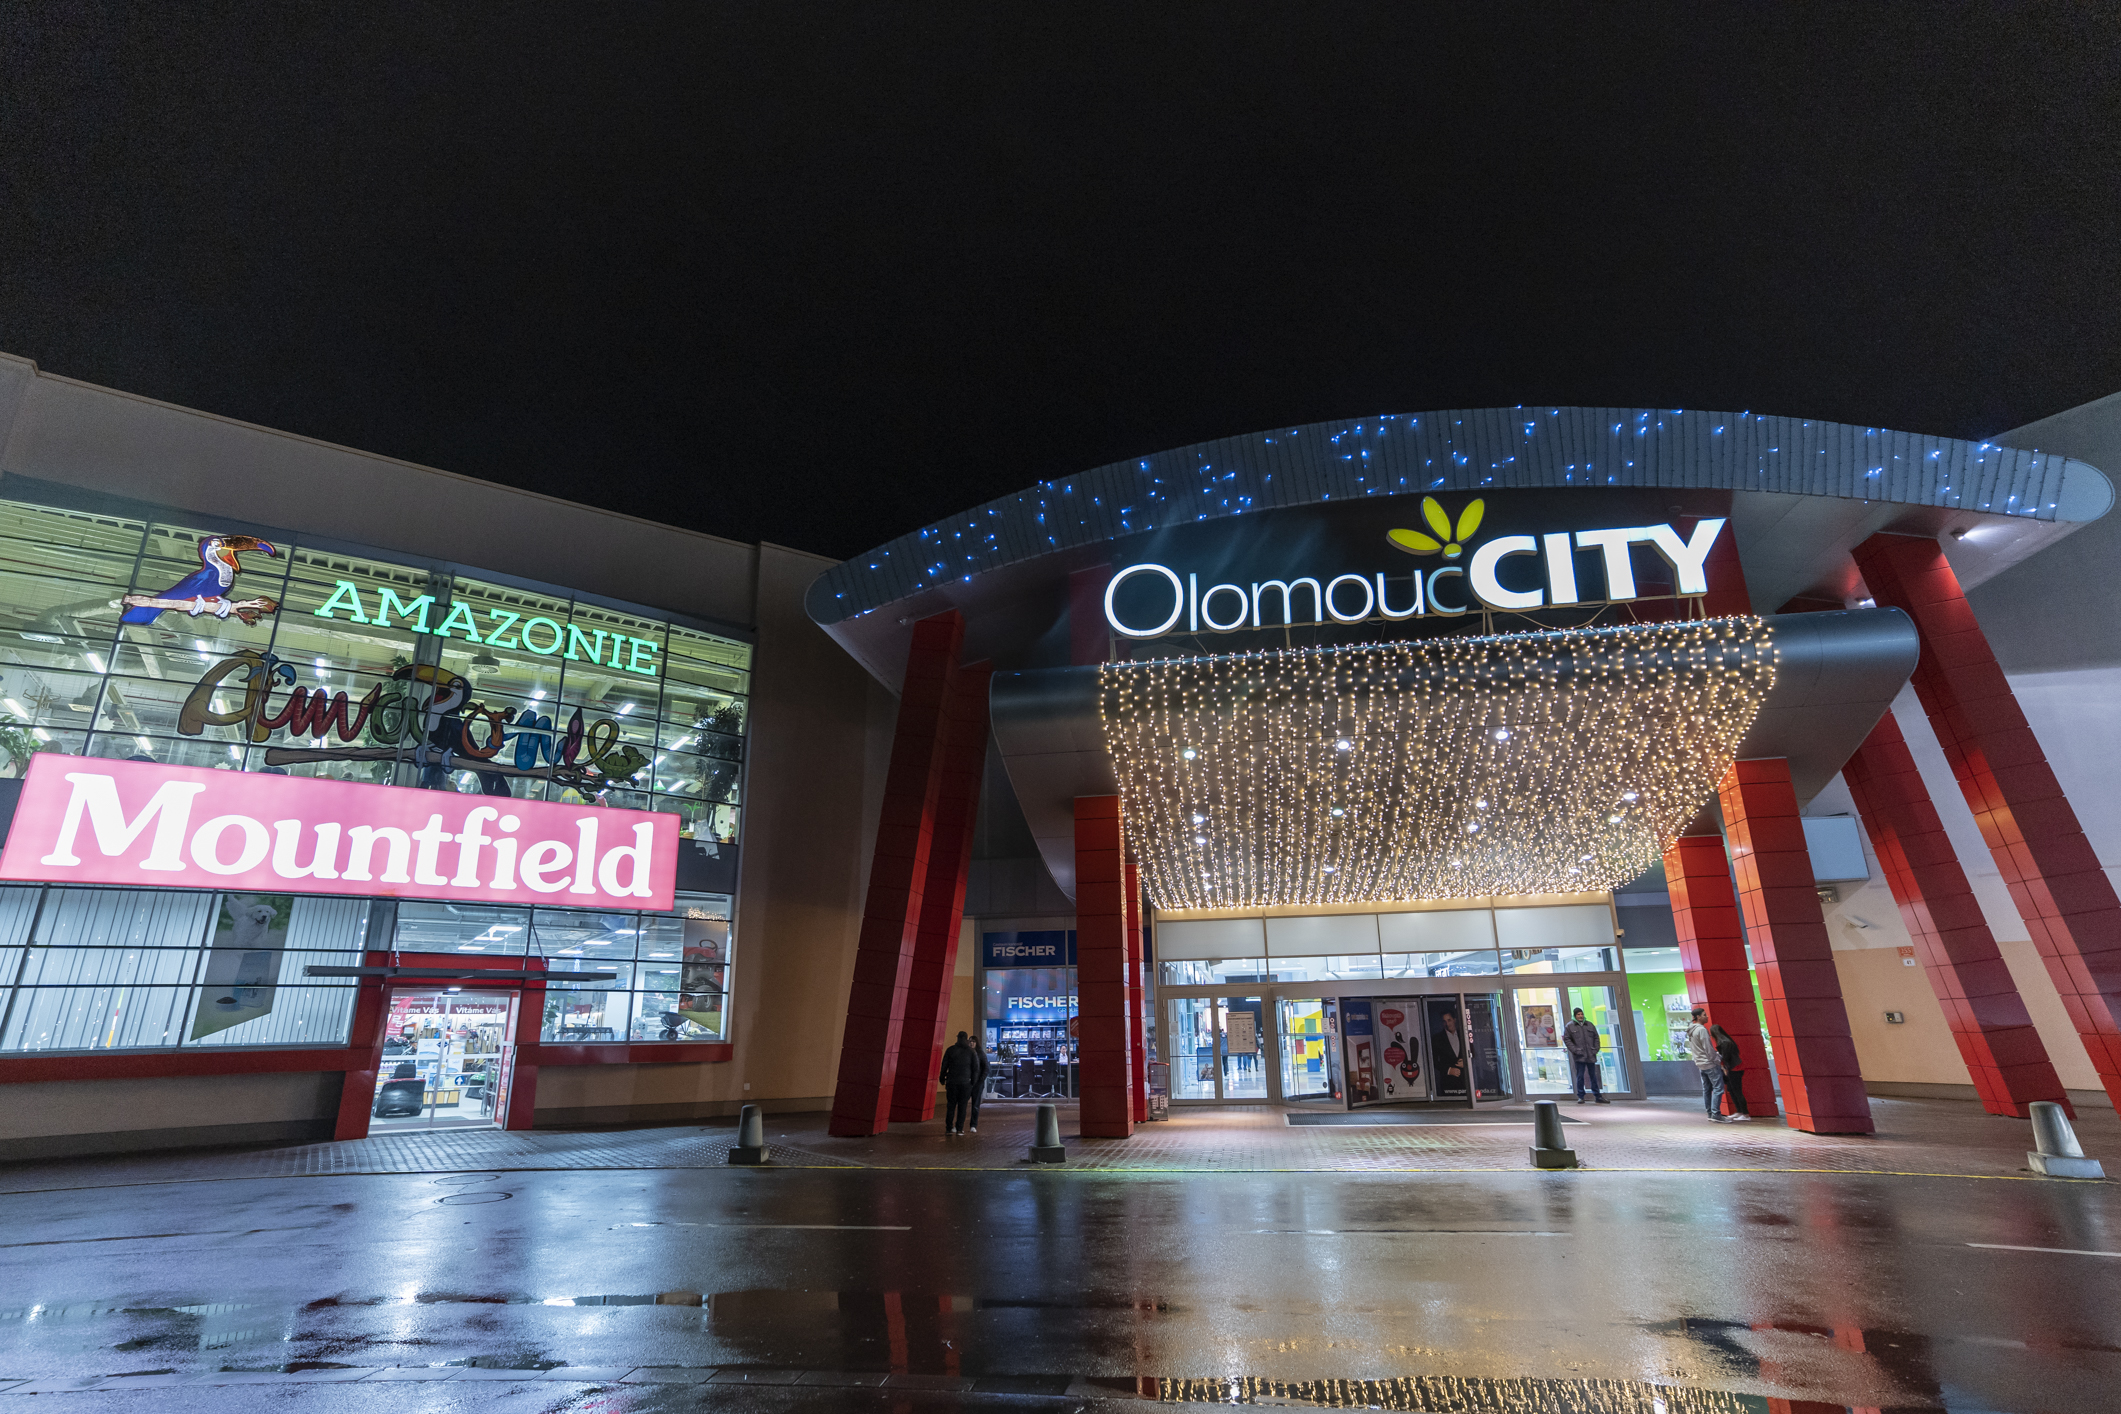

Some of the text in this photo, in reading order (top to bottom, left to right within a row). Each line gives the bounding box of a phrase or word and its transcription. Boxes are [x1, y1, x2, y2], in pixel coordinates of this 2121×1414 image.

[1104, 517, 1726, 637] Olomouc CITY
[314, 579, 659, 676] AMAZONIE
[41, 771, 654, 898] Mountfield
[993, 946, 1056, 957] FISCHER
[1008, 995, 1078, 1009] FISCHER
